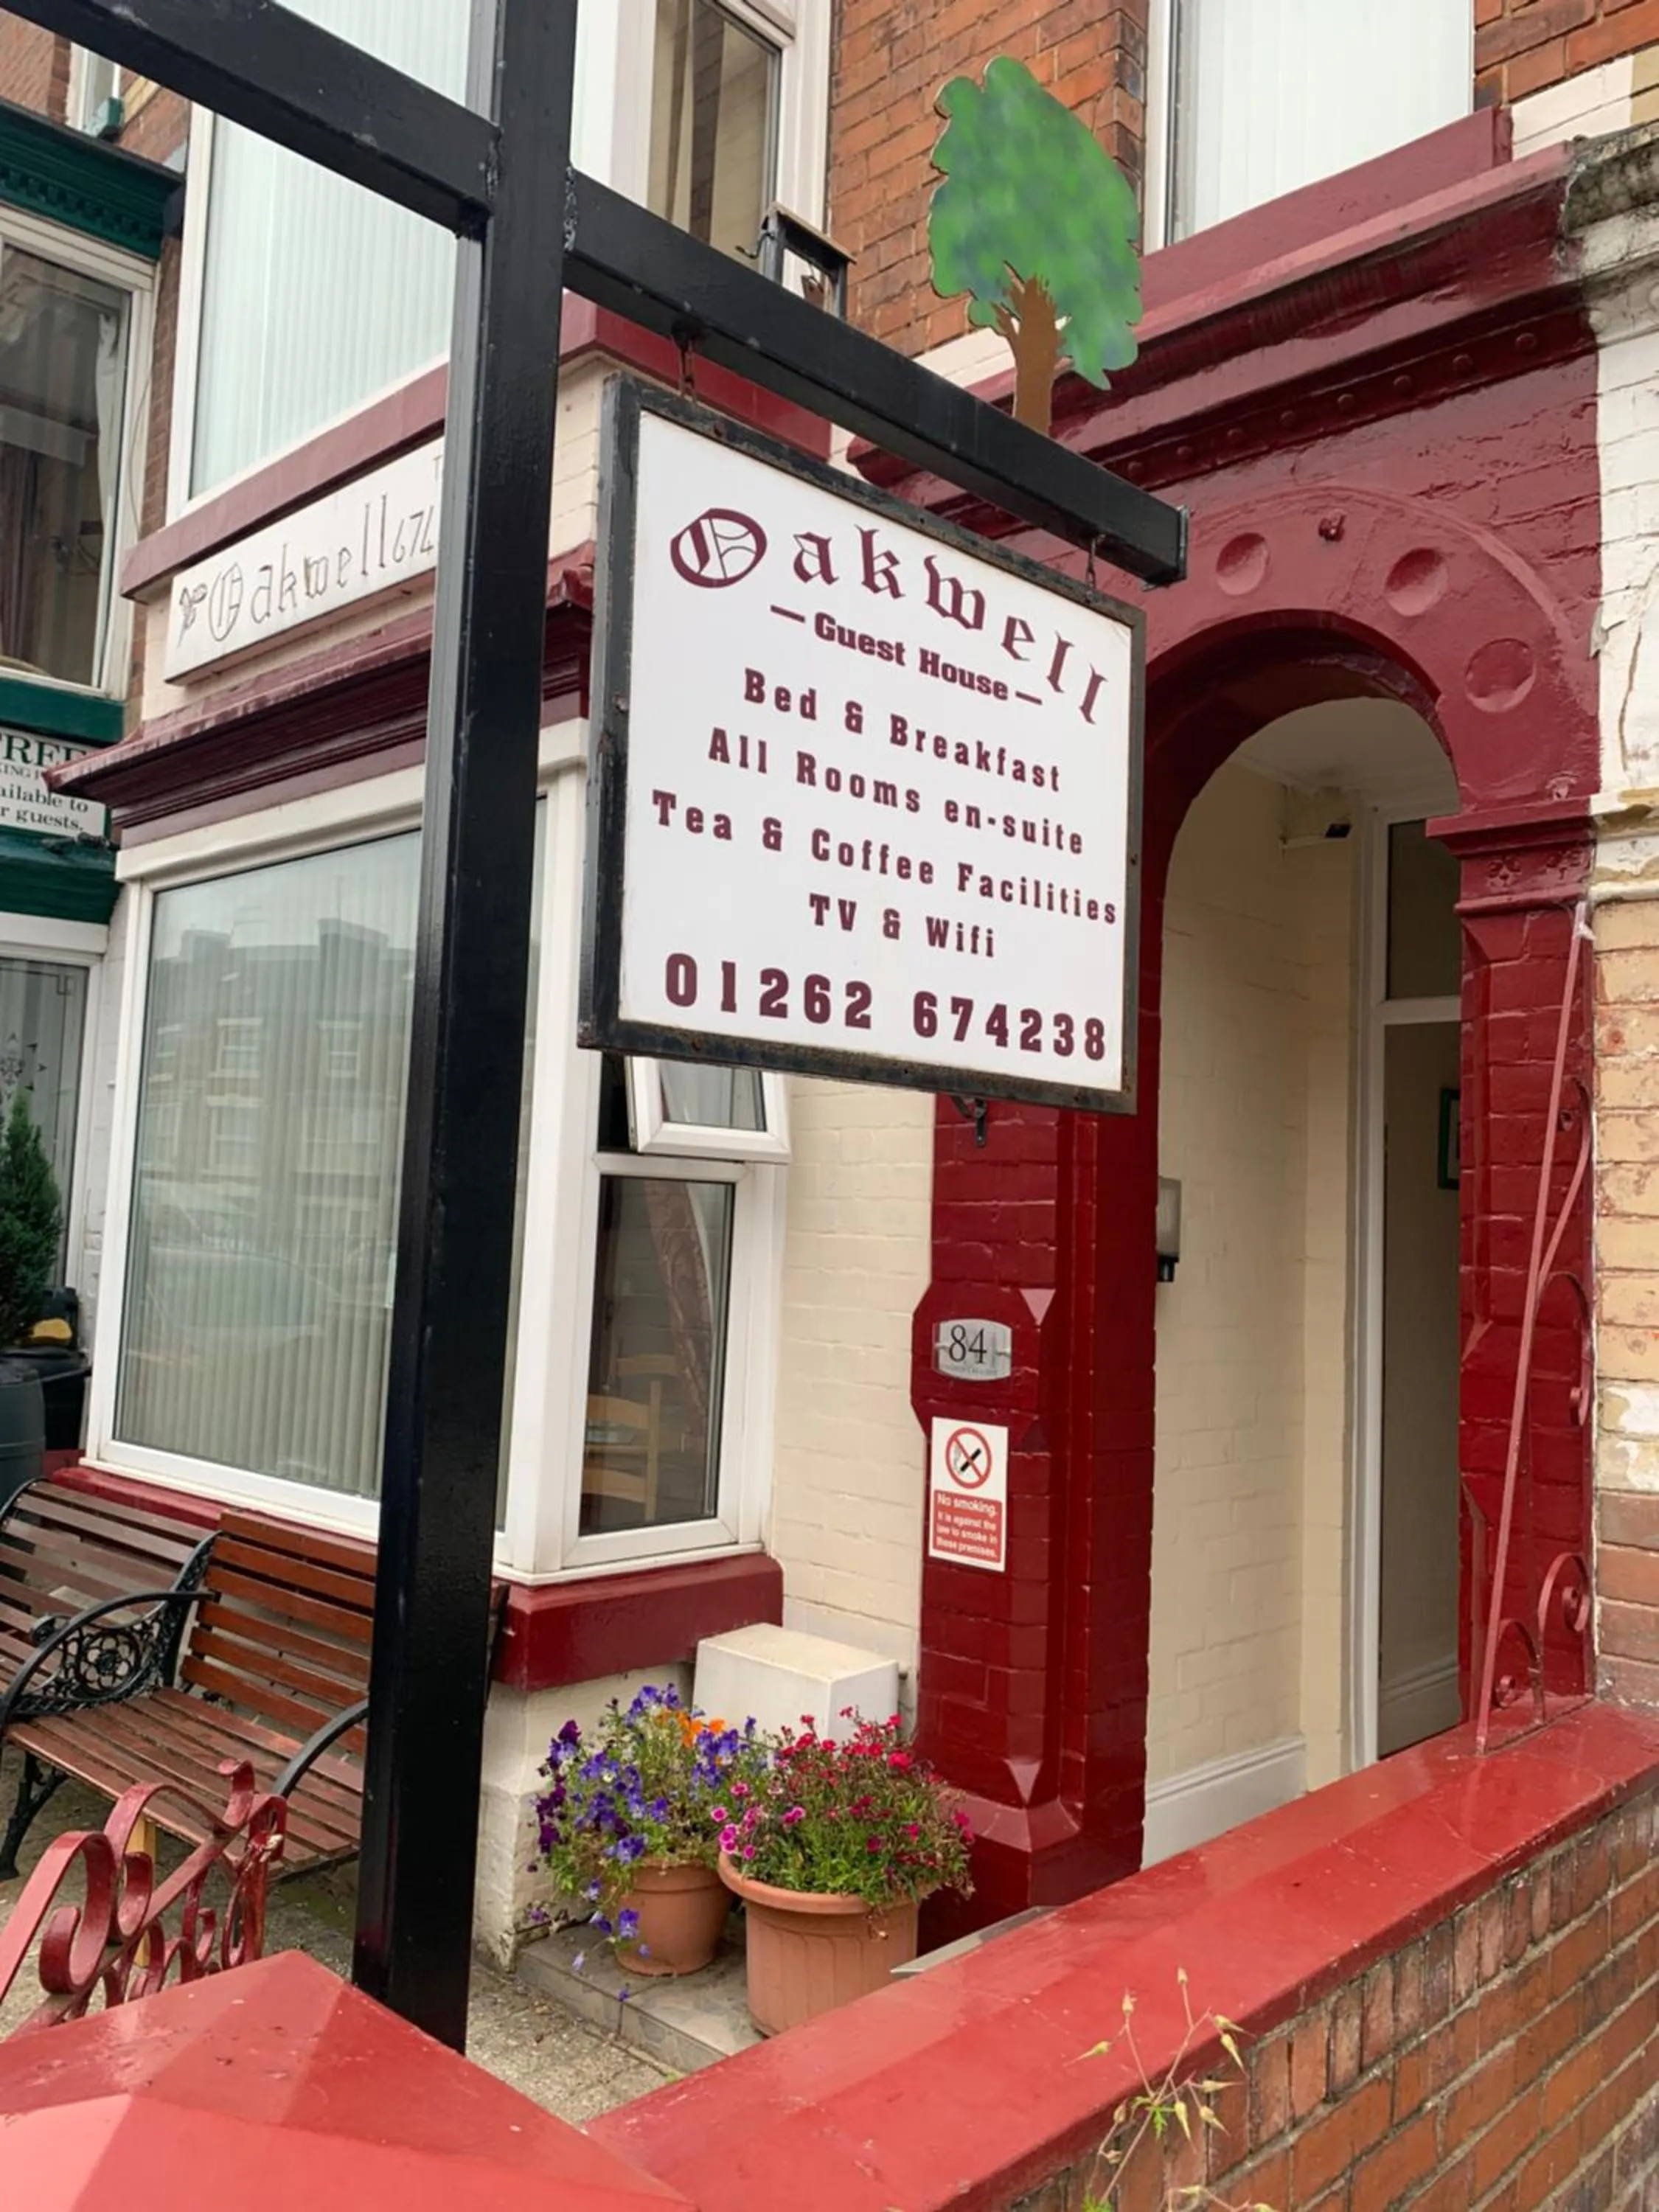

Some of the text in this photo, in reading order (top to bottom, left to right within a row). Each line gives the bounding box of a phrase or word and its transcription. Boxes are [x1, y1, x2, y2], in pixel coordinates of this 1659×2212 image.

[209, 493, 387, 642] Oakwell
[669, 507, 1106, 724] Oakwell
[814, 611, 1009, 701] Guest House
[744, 667, 1059, 793] Bed & Breakfast
[70, 799, 88, 813] to
[708, 727, 1082, 855] All Rooms en-suite
[652, 789, 1116, 925] Tea & Coffee Facilities
[809, 892, 994, 958] TV & Wifi
[665, 953, 1105, 1061] 01262 674238
[949, 1324, 987, 1365] 84
[937, 1492, 951, 1506] No
